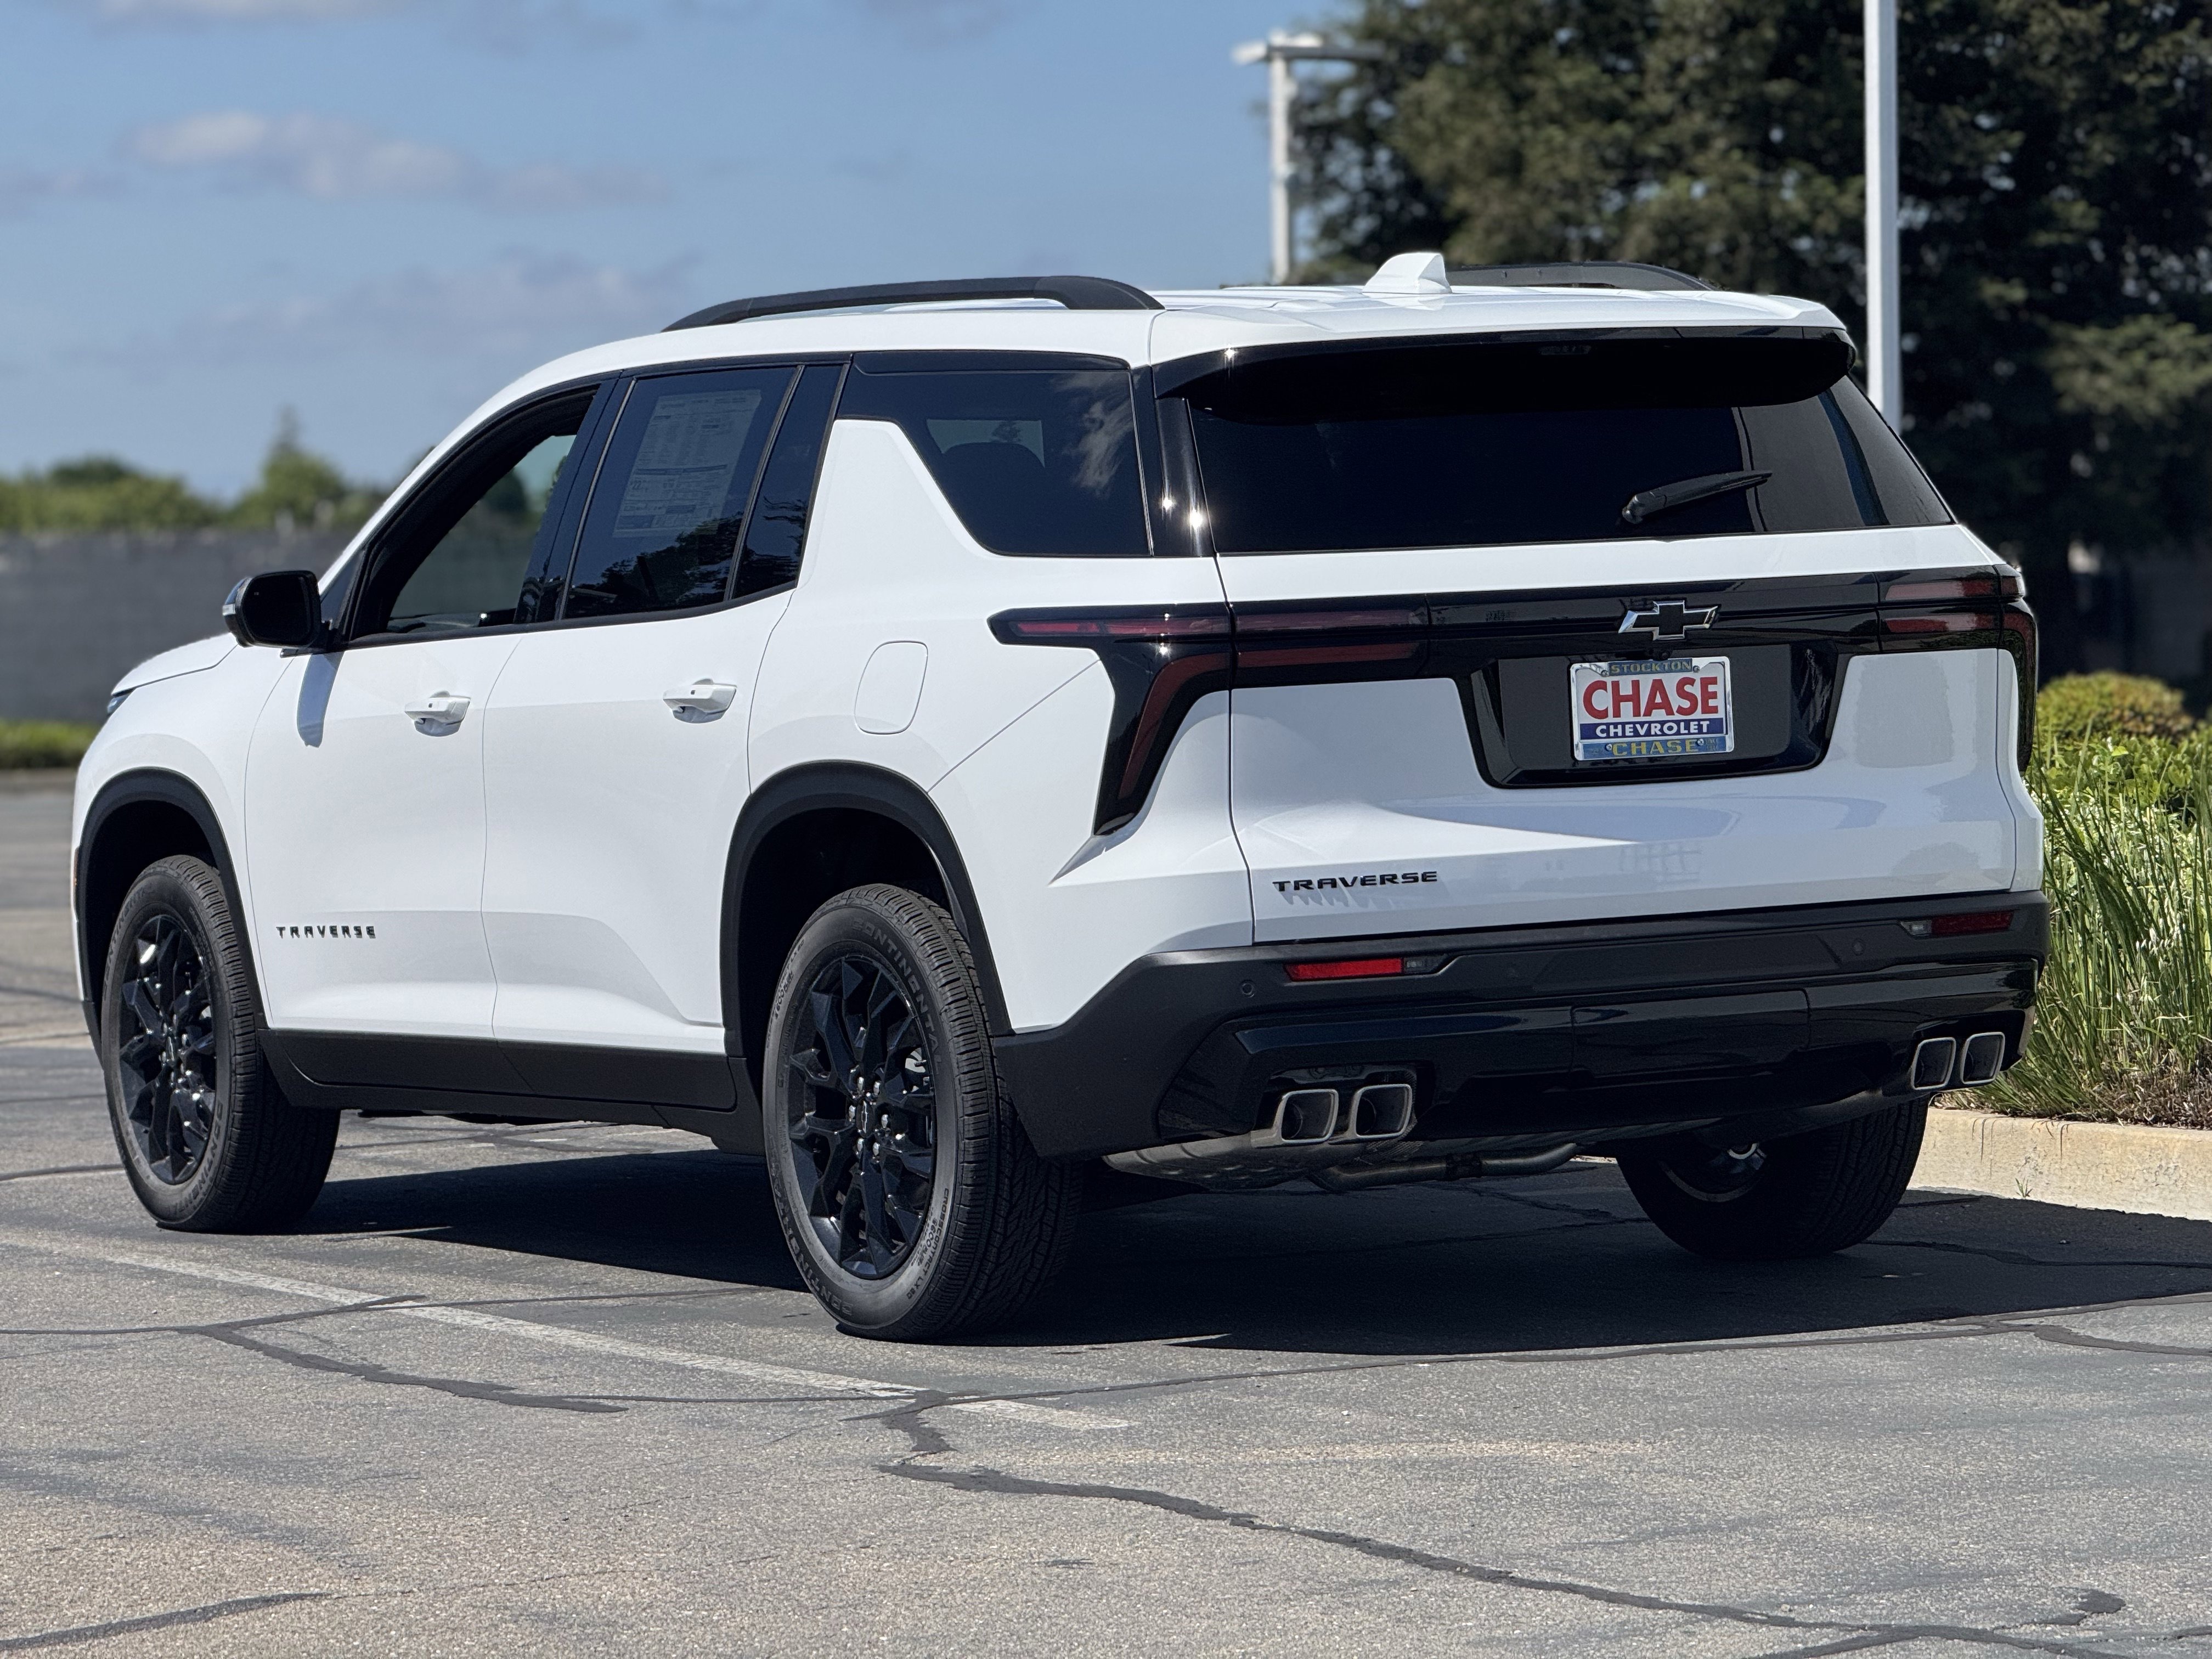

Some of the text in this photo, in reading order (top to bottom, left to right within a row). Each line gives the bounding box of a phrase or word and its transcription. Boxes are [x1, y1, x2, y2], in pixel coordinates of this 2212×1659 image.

[1610, 661, 1691, 674] STOCKTON
[1582, 676, 1719, 720] CHASE
[1595, 721, 1710, 737] CHEVROLET
[1612, 739, 1699, 756] CHASE
[1272, 871, 1437, 891] TRAVERSE
[276, 925, 376, 939] TRAVERSE
[851, 917, 942, 1075] CONTINENTAL
